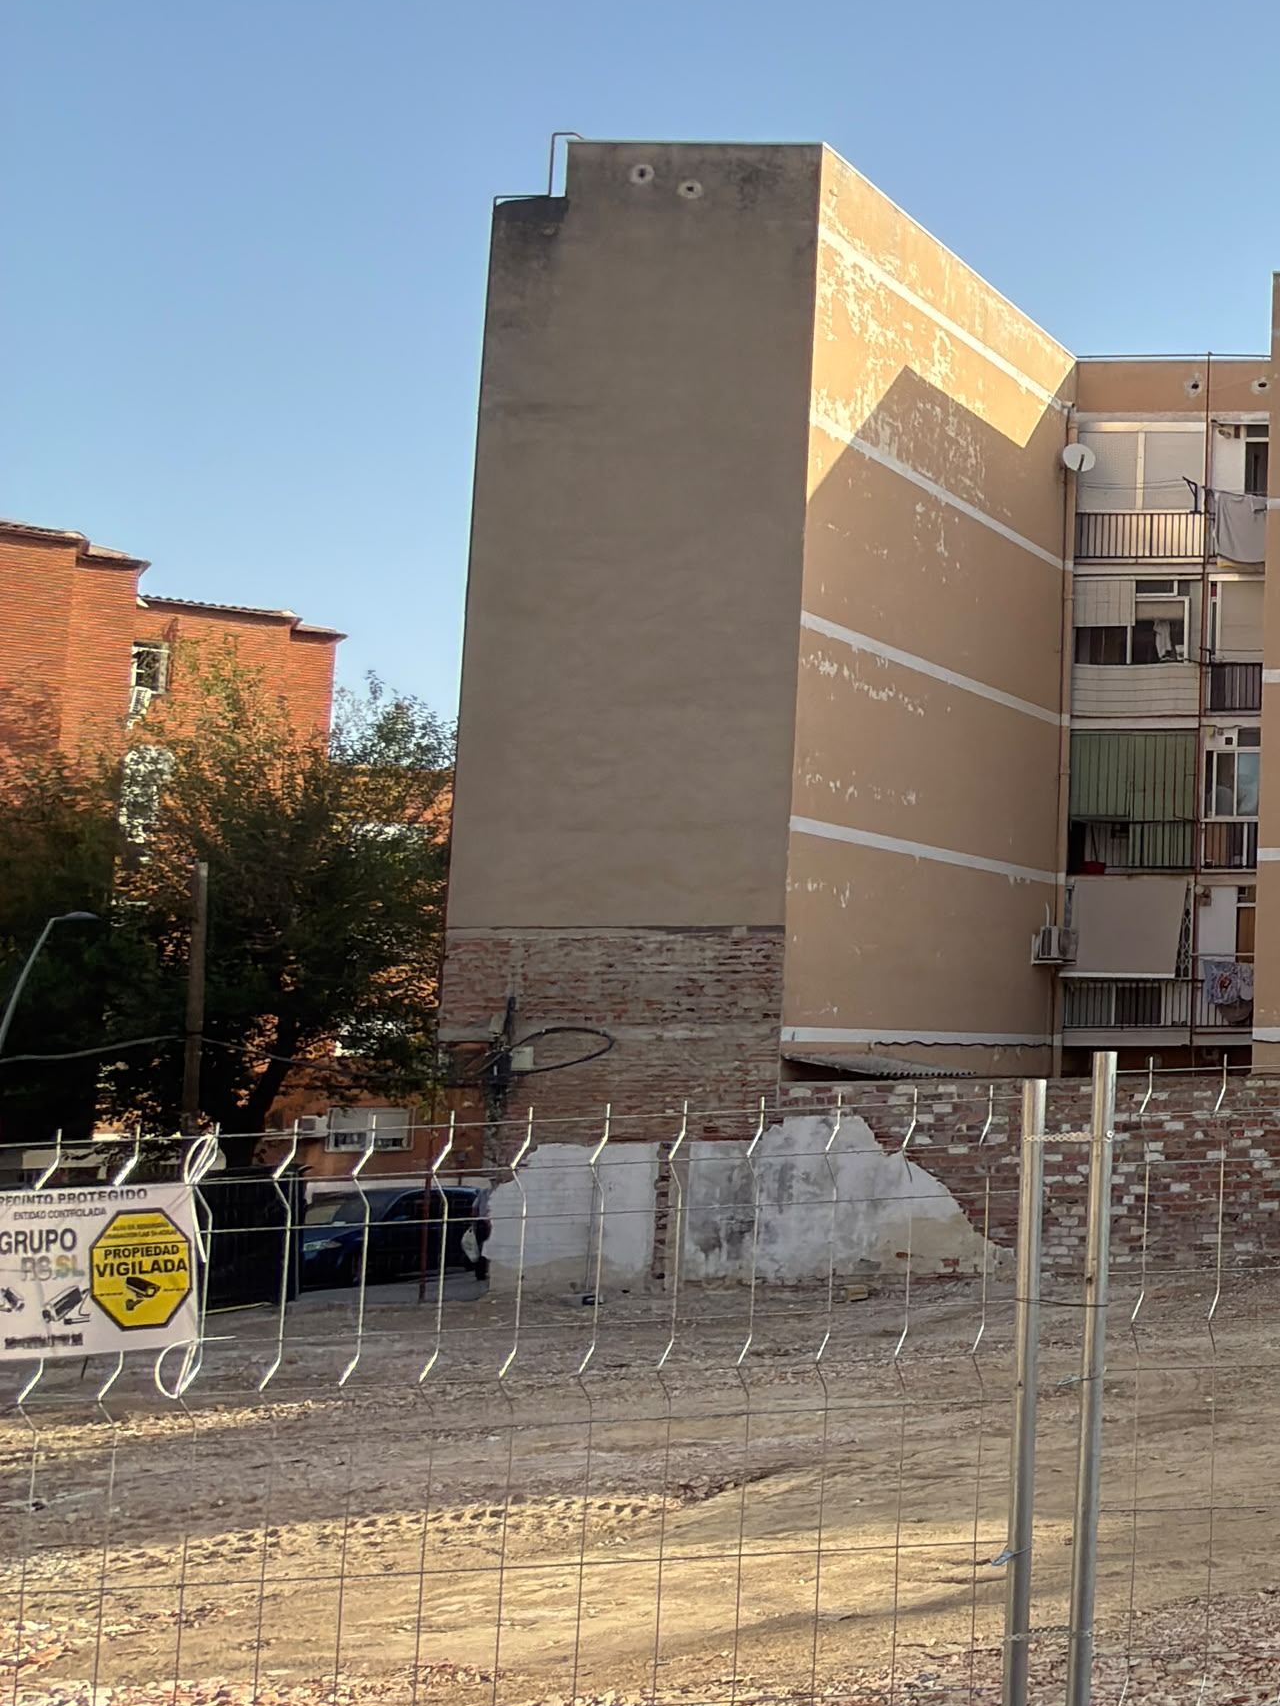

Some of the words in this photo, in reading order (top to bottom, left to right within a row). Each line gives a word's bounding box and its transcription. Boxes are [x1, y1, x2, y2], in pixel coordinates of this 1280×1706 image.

[57, 1188, 147, 1204] PROTEGIDO
[48, 1207, 107, 1219] CONTROLADA
[0, 1228, 77, 1255] GRUPO
[104, 1245, 179, 1260] PROPIEDAD
[96, 1258, 187, 1278] VIGILADA
